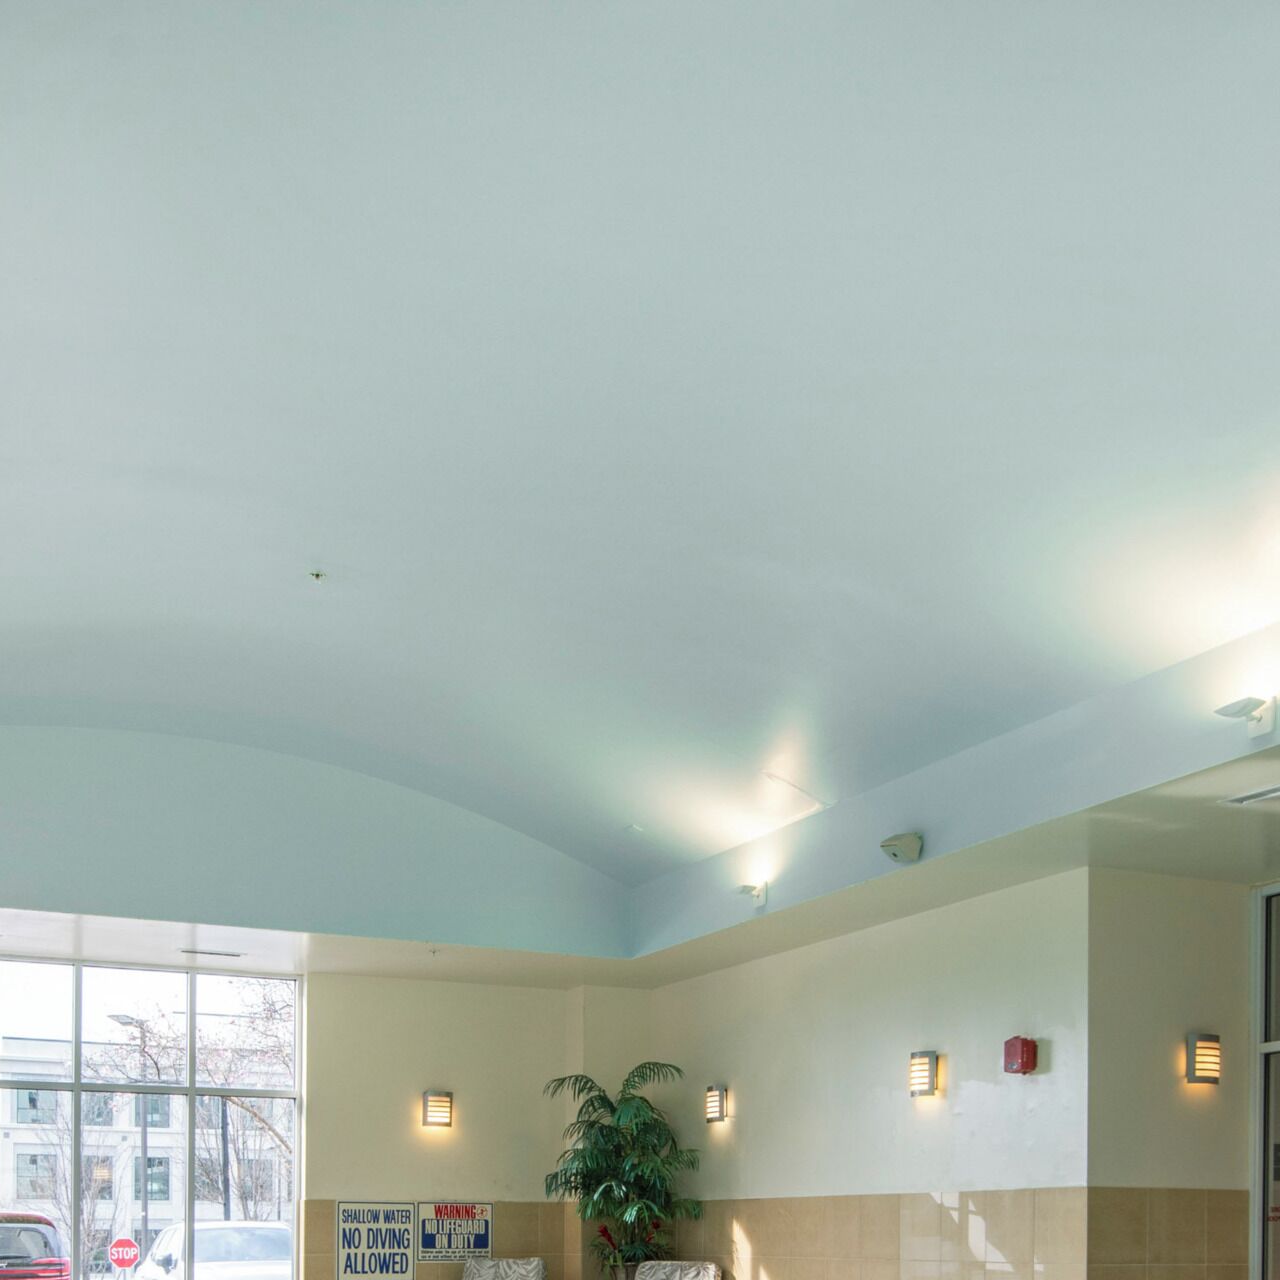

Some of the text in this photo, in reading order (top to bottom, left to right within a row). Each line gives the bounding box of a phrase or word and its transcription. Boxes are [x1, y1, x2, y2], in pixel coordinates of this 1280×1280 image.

[341, 1208, 411, 1225] SHALLOW WATER
[434, 1204, 477, 1219] WARNING
[424, 1219, 486, 1235] NO LIFEGUARD
[342, 1227, 410, 1250] NO DIVING
[435, 1234, 475, 1249] ON DUTY
[111, 1247, 138, 1260] STOP
[344, 1252, 409, 1275] ALLOWED
